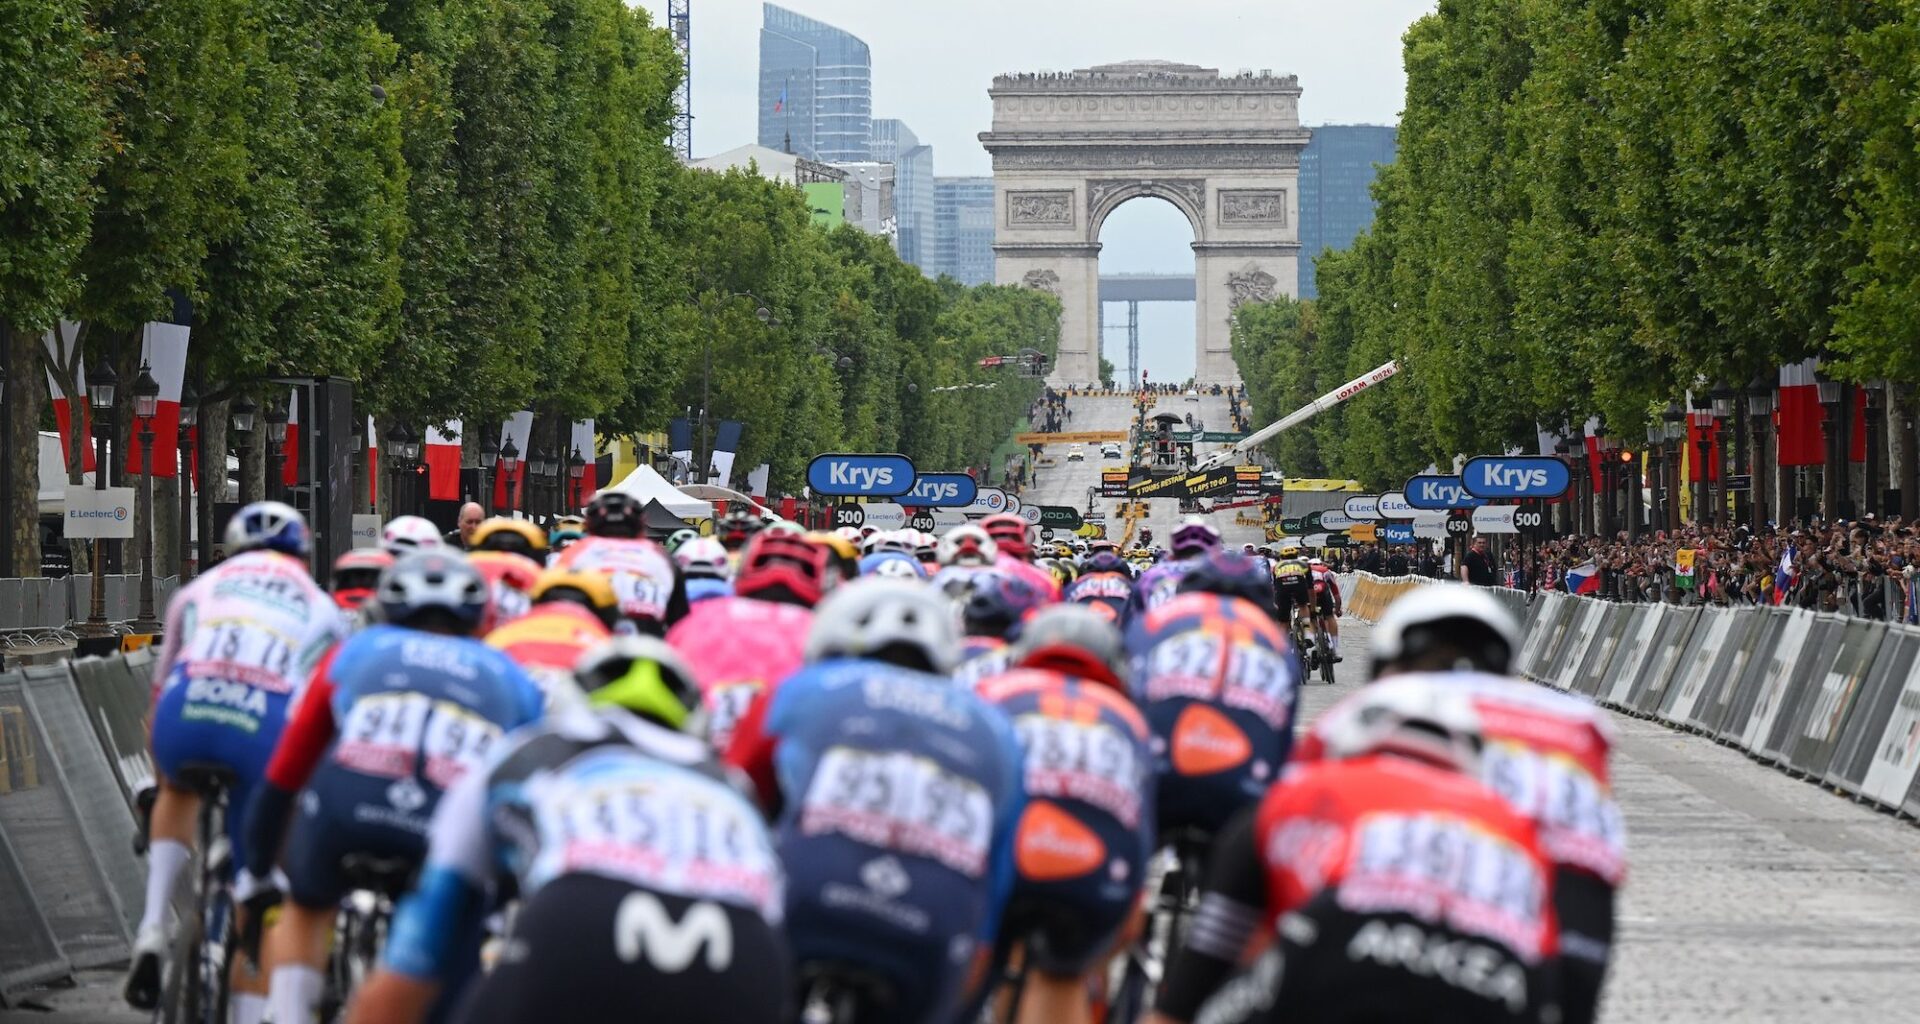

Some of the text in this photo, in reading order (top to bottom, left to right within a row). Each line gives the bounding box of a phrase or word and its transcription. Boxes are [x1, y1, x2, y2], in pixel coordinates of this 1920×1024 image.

[1336, 381, 1367, 400] LOXAM
[830, 462, 893, 490] Krys
[1484, 463, 1548, 491] Krys
[907, 478, 959, 502] Krys
[1141, 482, 1160, 494] TOURS
[1194, 482, 1209, 493] LAPS
[1209, 479, 1218, 488] TO
[1218, 476, 1228, 485] GO
[1348, 504, 1378, 512] E.Lecl
[1382, 501, 1413, 511] E.Lec
[70, 510, 114, 519] E.Leclerc
[837, 511, 863, 524] 500
[1515, 513, 1541, 527] 500
[913, 518, 934, 529] 450
[1448, 520, 1469, 532] 450
[1375, 527, 1385, 537] 35
[1387, 529, 1410, 540] Krys
[186, 677, 268, 718] BORA
